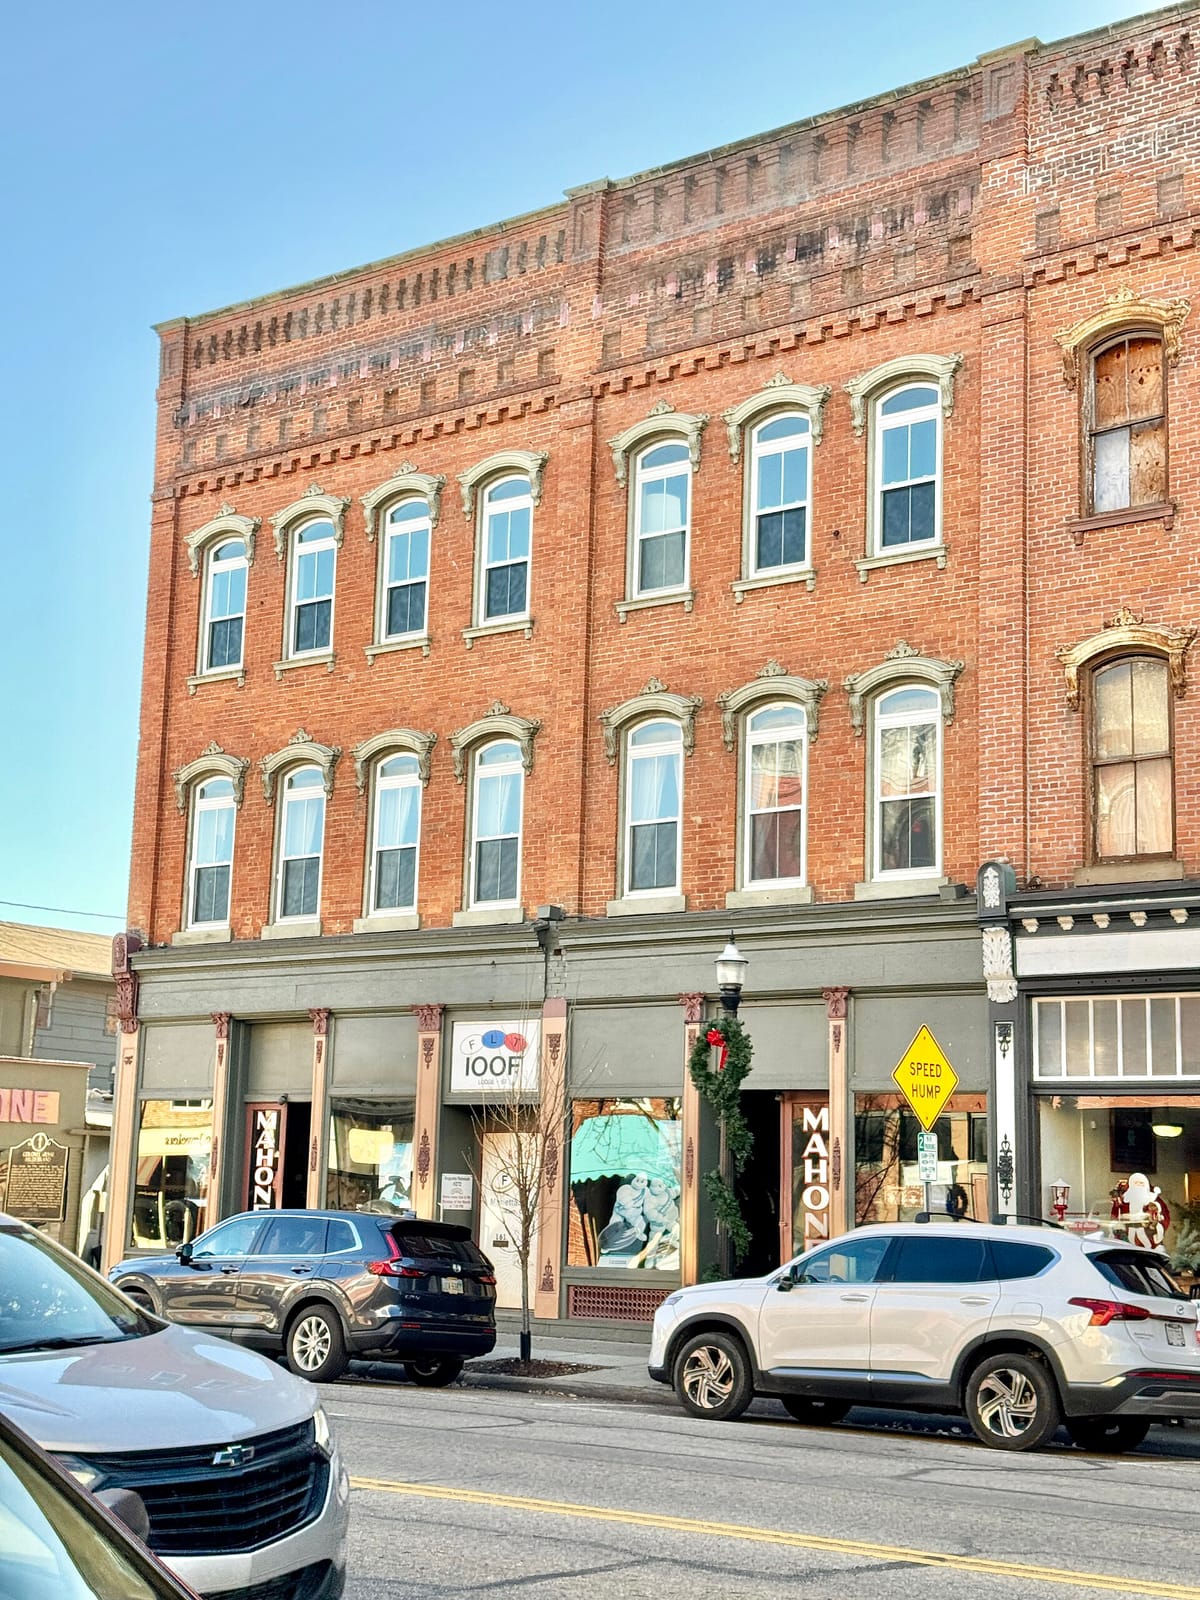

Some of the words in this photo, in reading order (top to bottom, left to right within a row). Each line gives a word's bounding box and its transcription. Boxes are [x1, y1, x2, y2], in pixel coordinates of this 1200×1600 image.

[469, 1040, 475, 1050] F
[490, 1034, 497, 1044] L
[465, 1056, 523, 1077] IOOF
[909, 1062, 942, 1078] SPEED
[911, 1084, 941, 1099] HUMP
[502, 1175, 508, 1185] F
